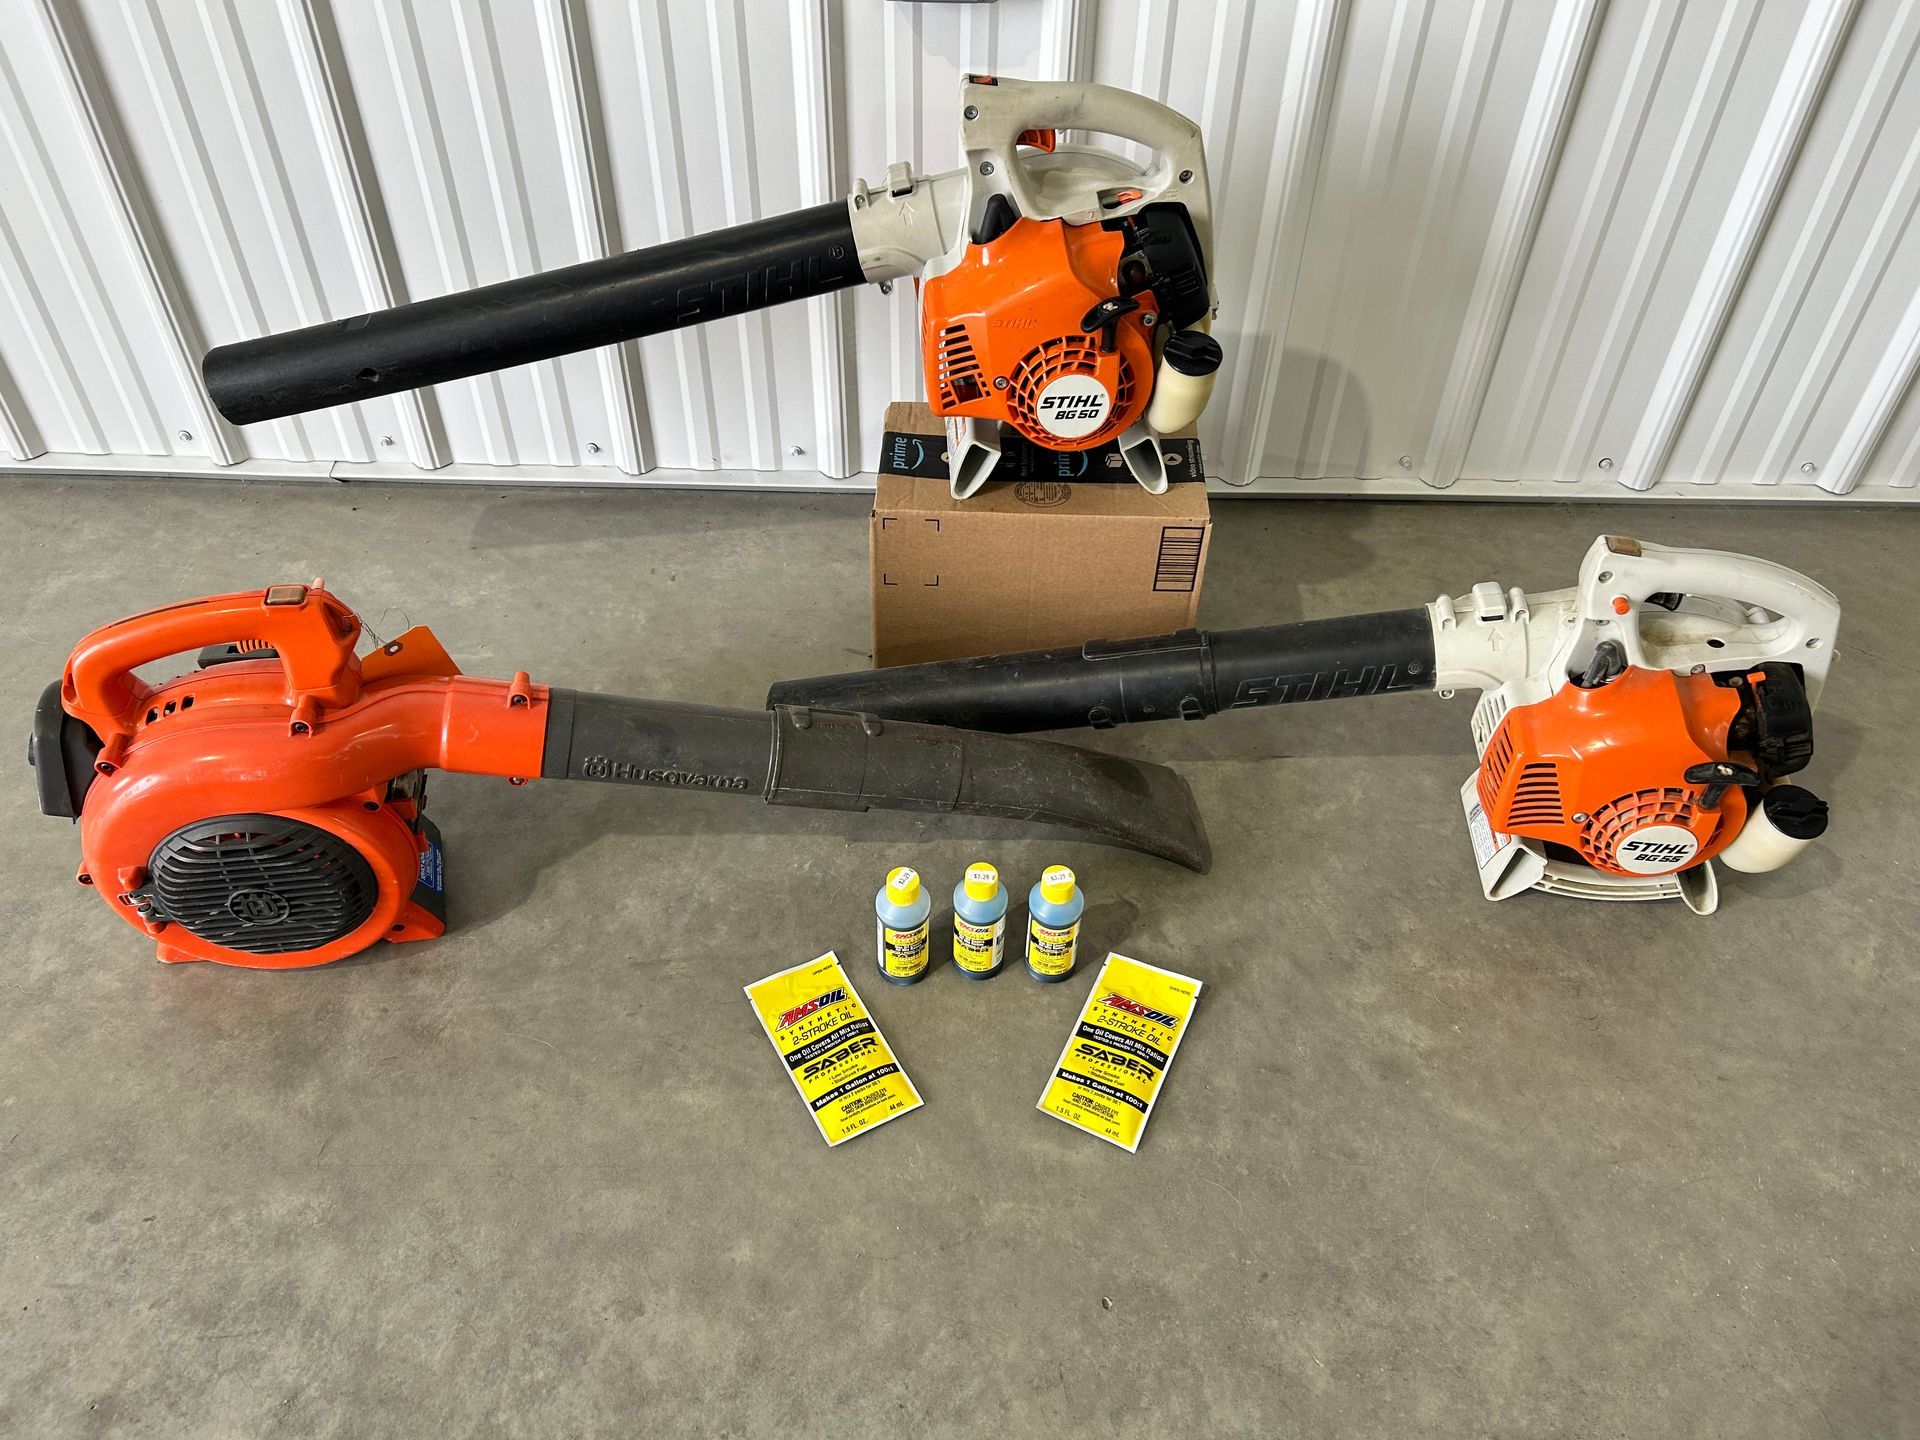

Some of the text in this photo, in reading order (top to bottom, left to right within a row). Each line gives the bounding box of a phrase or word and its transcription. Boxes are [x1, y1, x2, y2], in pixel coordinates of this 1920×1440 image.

[677, 256, 843, 323] STIHL
[992, 319, 1036, 330] STIHL
[1040, 395, 1103, 409] STIHL
[1055, 409, 1100, 420] BG 50
[889, 437, 909, 469] prime
[1053, 451, 1074, 476] prim
[1231, 664, 1416, 708] STIHL
[614, 762, 748, 789] Husqvarna
[1622, 841, 1689, 854] STIHL
[1634, 854, 1660, 862] BG
[780, 989, 847, 1027] AMSOIL
[780, 1003, 856, 1040] SYNTHETIC
[1093, 1006, 1172, 1041] SYNTHETIC
[1103, 994, 1176, 1027] AMSOIL
[789, 1022, 868, 1062] One Oil Covers All Mix Ratios
[792, 1011, 854, 1045] 2-STROKE OIL
[1082, 1025, 1094, 1033] One
[1095, 1028, 1104, 1036] Oil
[1104, 1032, 1124, 1043] Covers
[1134, 1042, 1145, 1051] Mix
[1146, 1048, 1164, 1062] Ratios
[1097, 1015, 1160, 1046] 2-STROKE OIL
[804, 1037, 877, 1079] SABER
[808, 1048, 877, 1083] PROFESSIONAL
[1075, 1054, 1146, 1084] PROFESSIONAL
[1076, 1044, 1154, 1080] SABER
[816, 1092, 838, 1106] Makes
[845, 1077, 867, 1090] Gallon
[876, 1066, 894, 1075] 100:1
[1062, 1072, 1084, 1082] Makes
[1092, 1082, 1114, 1094] Gallon
[1126, 1095, 1142, 1108] 100:1
